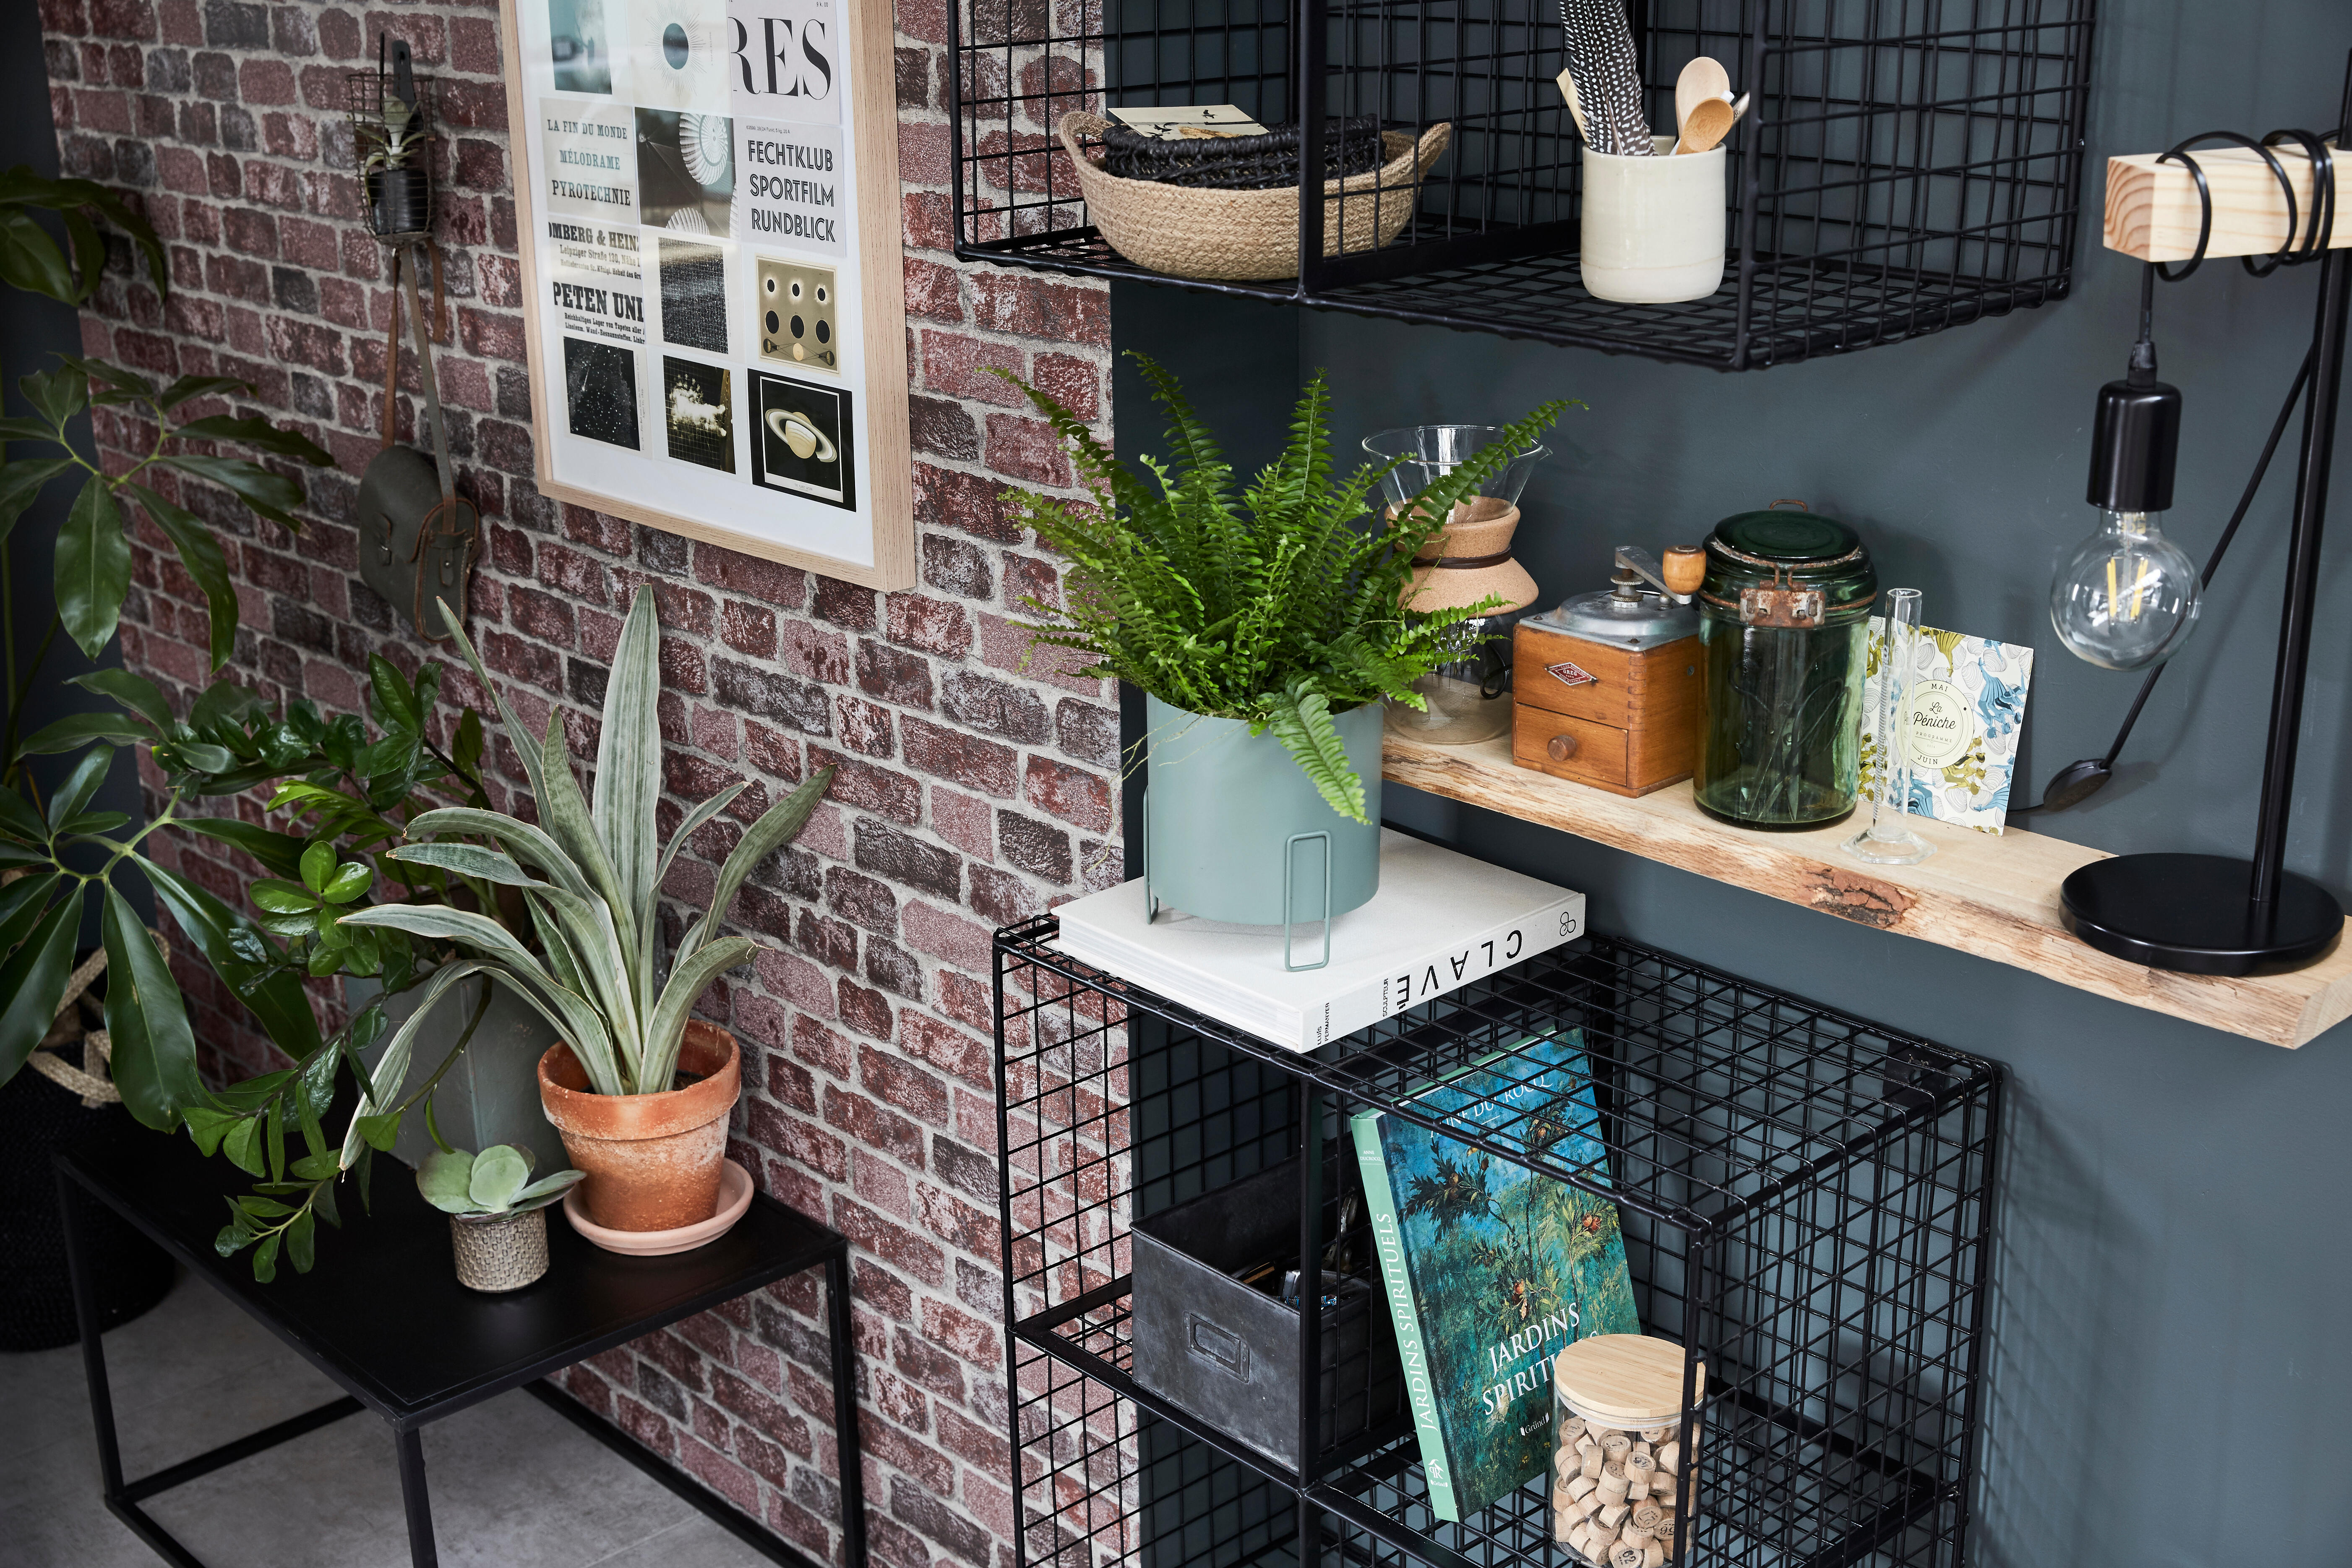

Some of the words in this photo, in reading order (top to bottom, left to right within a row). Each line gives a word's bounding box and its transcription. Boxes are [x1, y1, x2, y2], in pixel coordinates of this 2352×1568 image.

[728, 17, 831, 100] RES
[547, 120, 559, 131] LA
[563, 121, 578, 133] FIN
[582, 123, 594, 135] DU
[597, 125, 627, 139] MONDE
[559, 149, 620, 170] MÉLODRAME
[748, 140, 833, 172] FECHTKLUB
[552, 180, 630, 206] PYROTECHNIE
[750, 174, 834, 207] SPORTFILM
[751, 208, 836, 243] RUNDBLICK
[597, 230, 606, 246] &
[560, 244, 587, 258] Leipziger
[588, 249, 607, 261] Straße
[609, 253, 620, 264] 130,
[613, 268, 626, 277] Hoheit
[553, 282, 607, 315] PETEN
[565, 313, 591, 324] Reichhaltiges
[593, 318, 604, 327] Lager
[615, 322, 631, 331] Tapeten
[1931, 683, 1948, 692] MAI
[1930, 702, 1943, 714] La
[1914, 712, 1956, 729] Péniche
[1916, 731, 1953, 743] PROGRAMME
[1918, 755, 1938, 764] JUIN
[1397, 929, 1522, 1010] CLAVÉ
[1377, 1213, 1413, 1332] SPIRITUELS
[1488, 1302, 1580, 1379] JARDINS
[1403, 1340, 1438, 1431] JARDINS
[1525, 1416, 1545, 1434] Gründ
